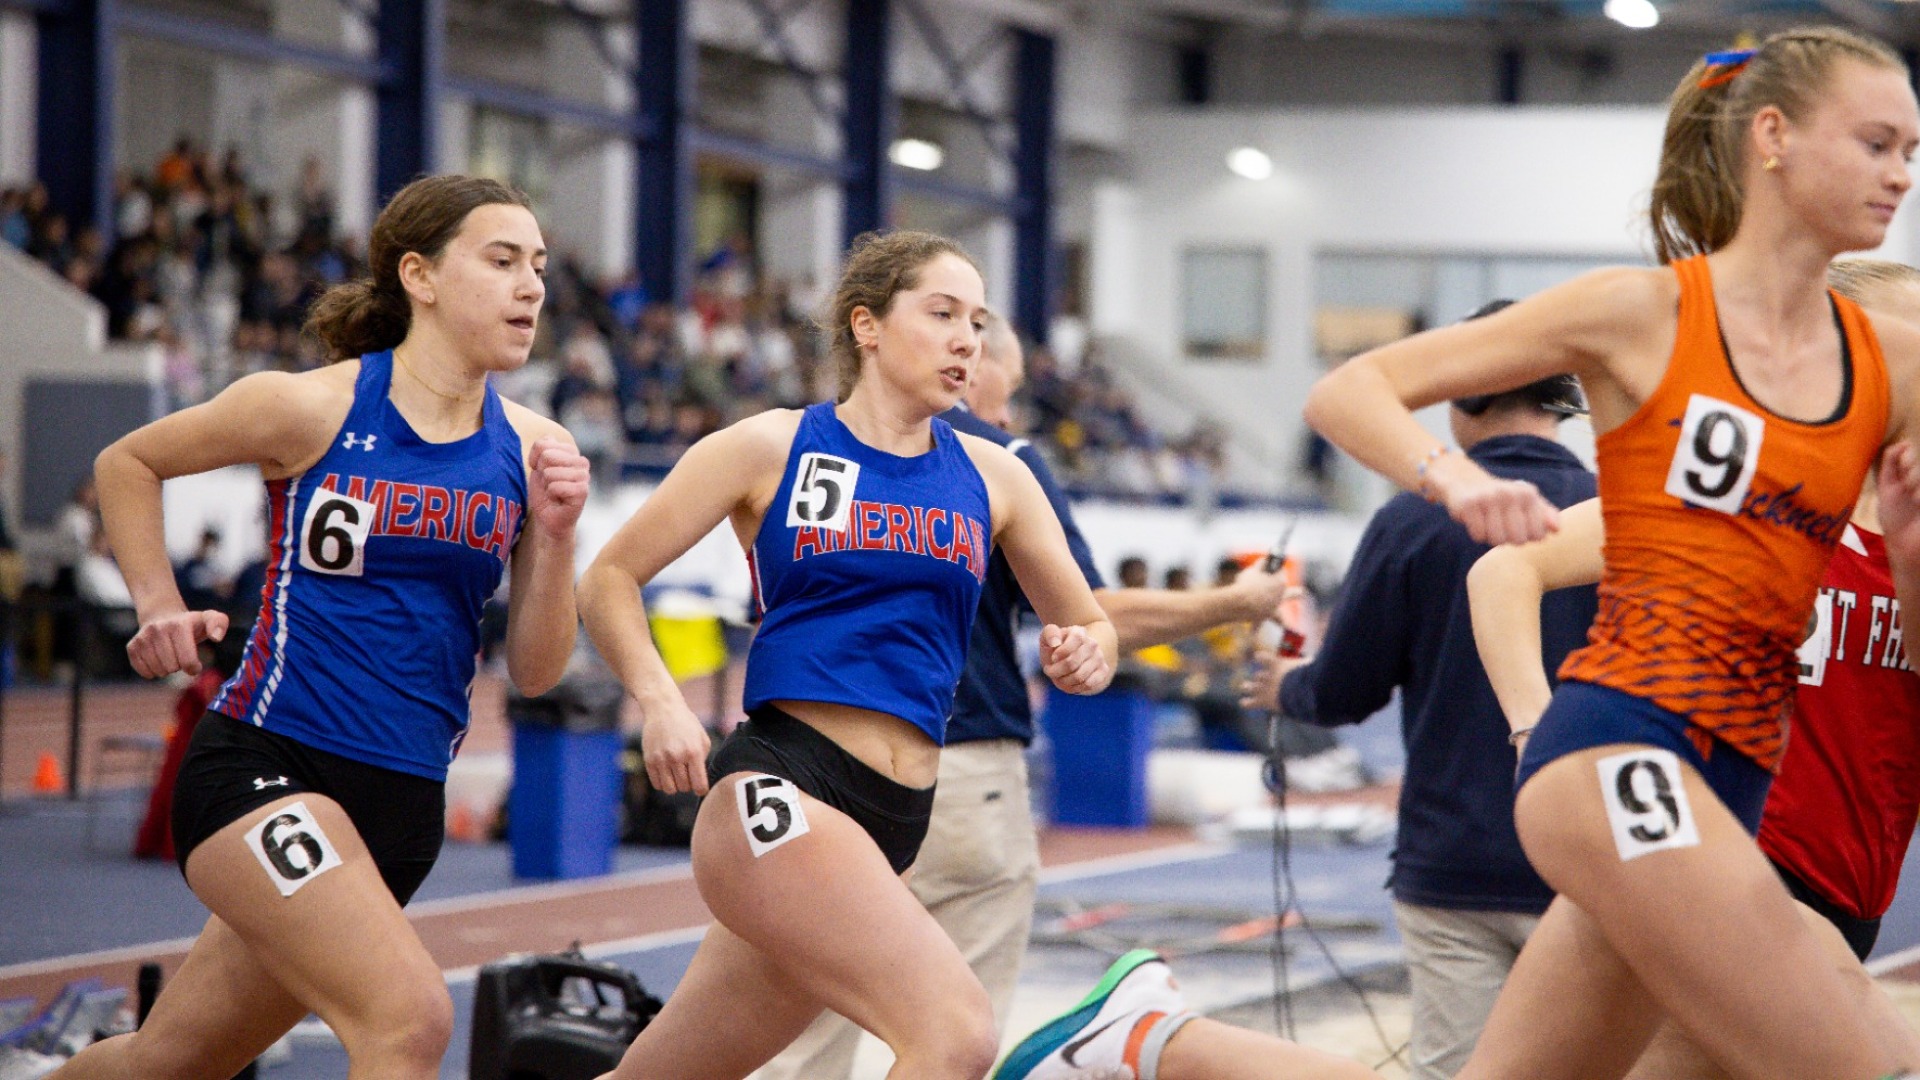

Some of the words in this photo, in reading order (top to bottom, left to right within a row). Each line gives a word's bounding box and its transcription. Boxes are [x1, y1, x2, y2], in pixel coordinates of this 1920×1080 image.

[796, 457, 846, 522] 5
[1685, 411, 1748, 499] 9
[308, 498, 360, 571] 6
[744, 777, 792, 844] 5
[1615, 759, 1680, 843] 9
[261, 813, 324, 881] 6
